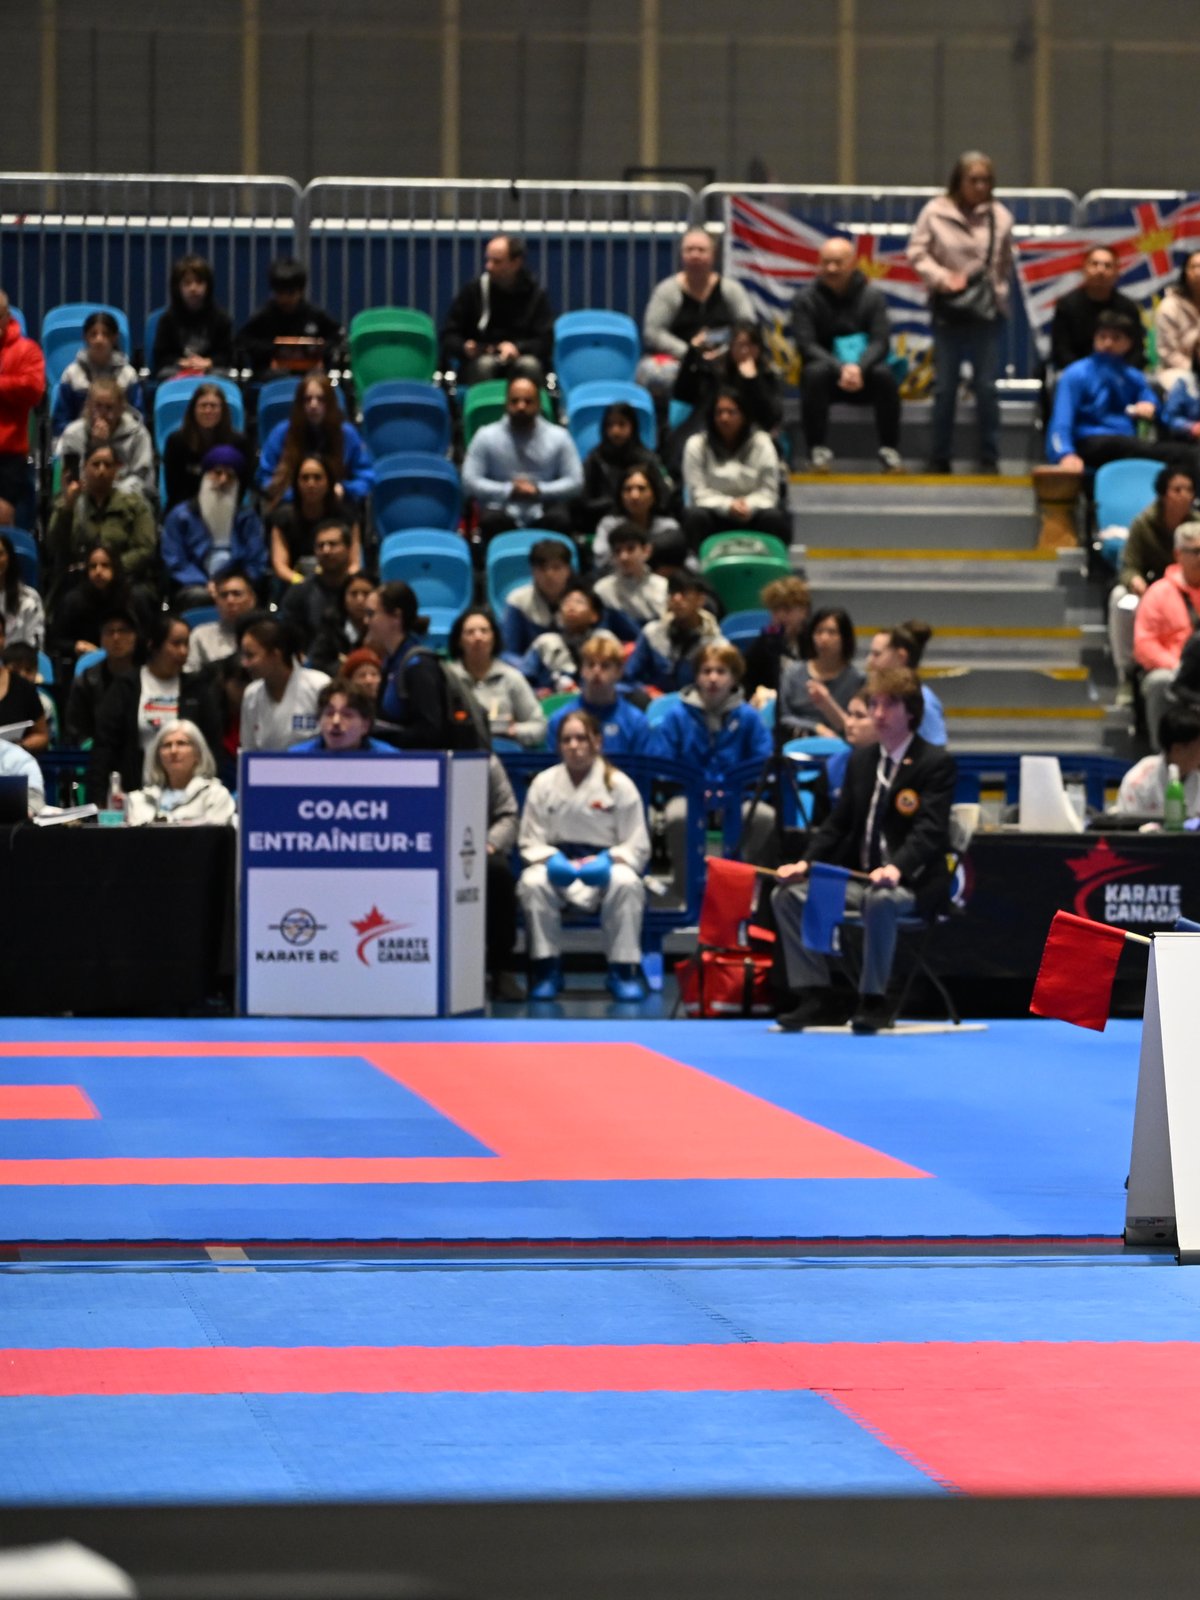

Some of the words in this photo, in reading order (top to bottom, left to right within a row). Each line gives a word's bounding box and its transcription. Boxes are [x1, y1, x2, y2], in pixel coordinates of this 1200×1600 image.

[298, 800, 389, 820] COACH
[1105, 884, 1182, 903] KARATE
[1105, 903, 1182, 922] CANADA
[378, 938, 429, 950] KARATE
[255, 951, 315, 962] KARATE
[319, 951, 339, 962] BC
[377, 951, 430, 963] CANADA
